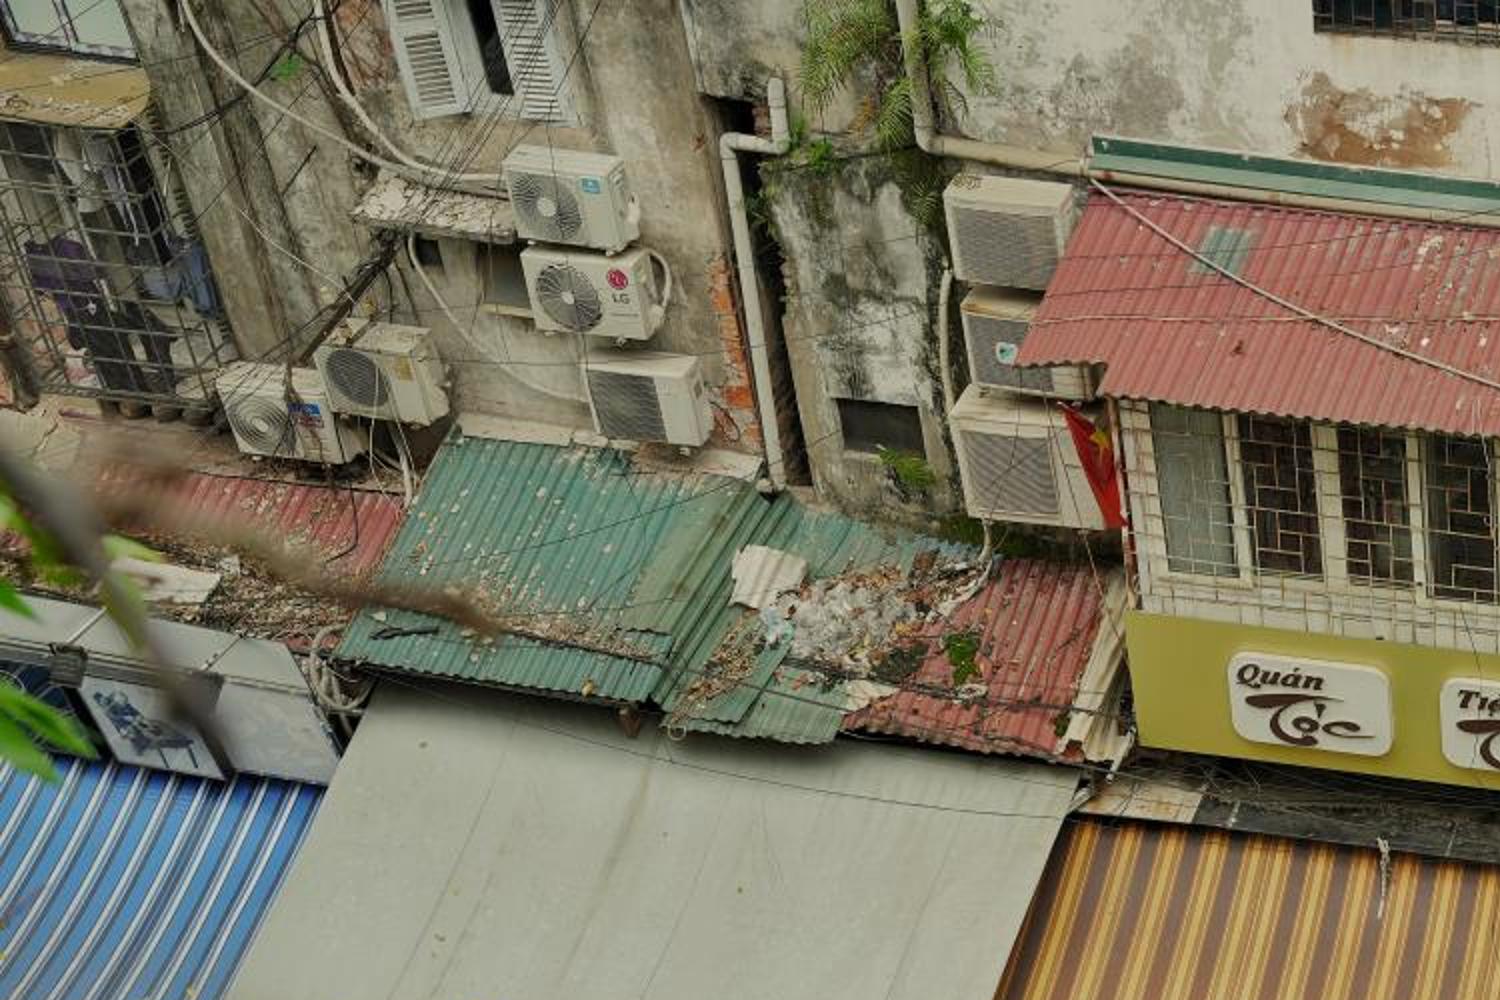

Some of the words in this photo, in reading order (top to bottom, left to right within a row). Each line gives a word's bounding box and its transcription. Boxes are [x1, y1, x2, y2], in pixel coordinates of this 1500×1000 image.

[611, 293, 630, 305] LG
[1236, 663, 1325, 691] Quán
[1245, 693, 1376, 747] Tóc
